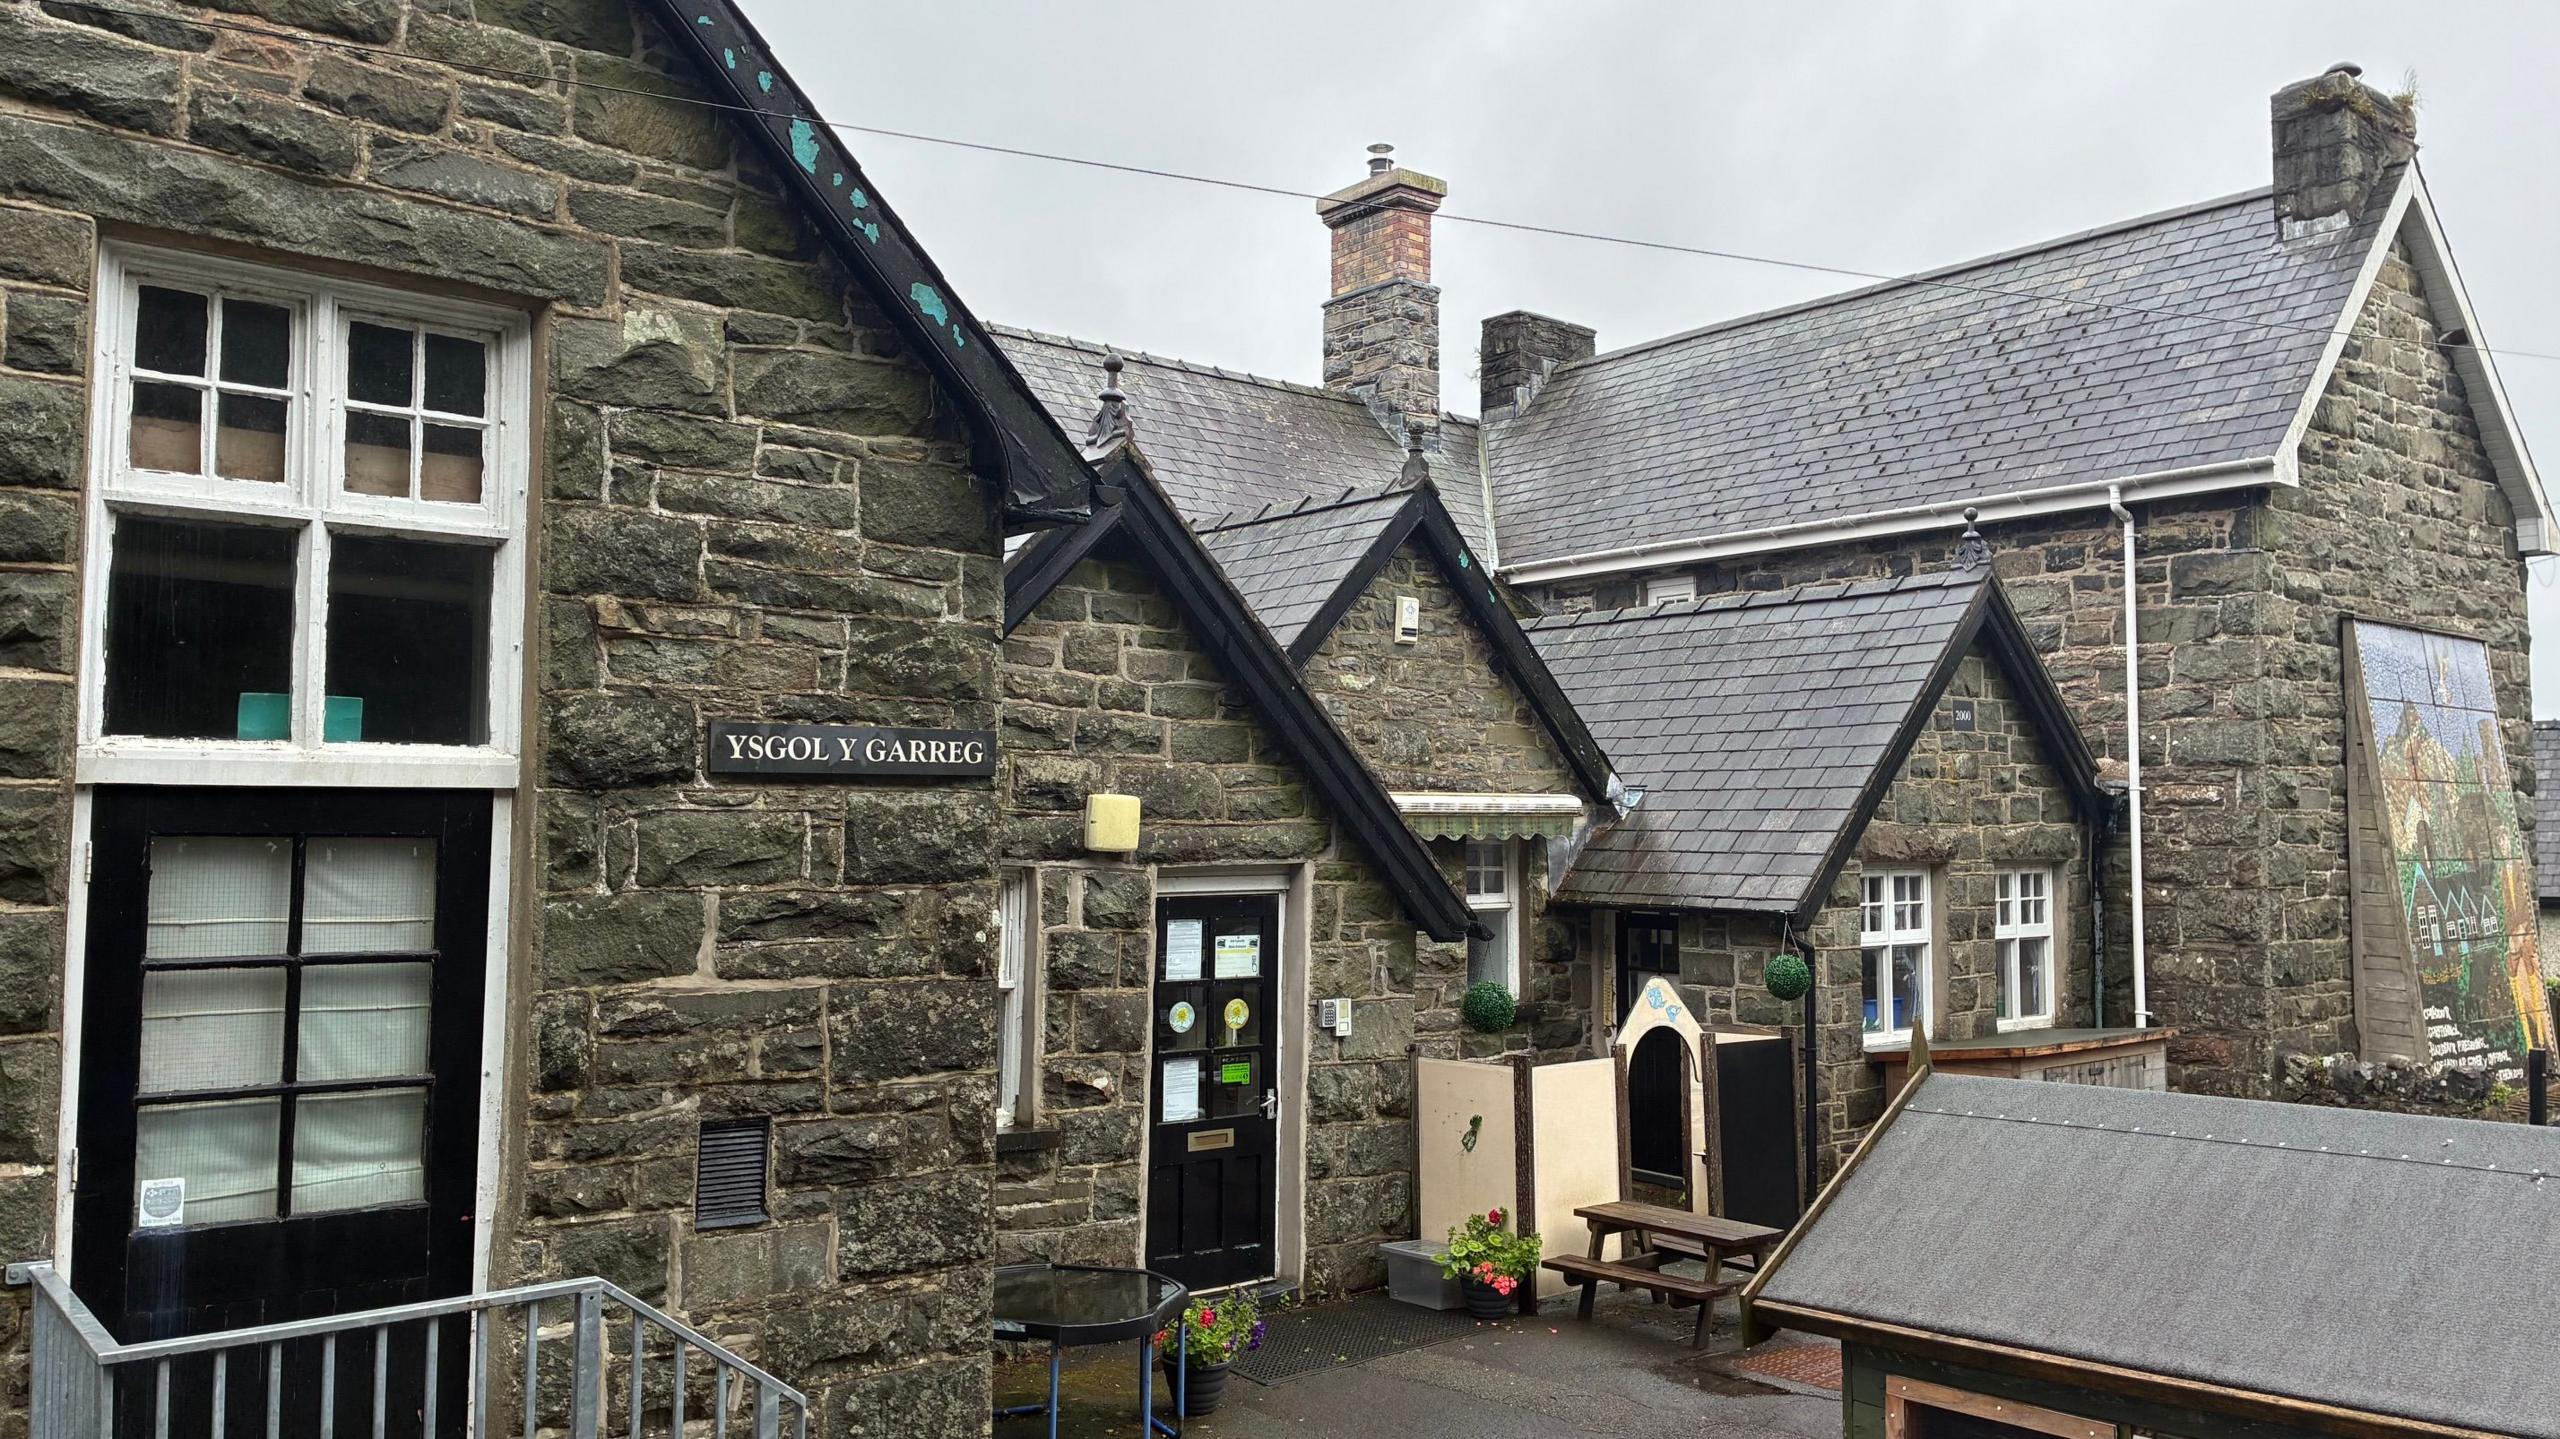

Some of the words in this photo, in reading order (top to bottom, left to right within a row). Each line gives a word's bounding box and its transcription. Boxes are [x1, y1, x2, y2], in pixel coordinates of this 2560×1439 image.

[1955, 710, 1972, 721] 2000
[726, 734, 830, 761] YSGOL
[836, 737, 857, 761] Y
[865, 738, 984, 764] GARREG
